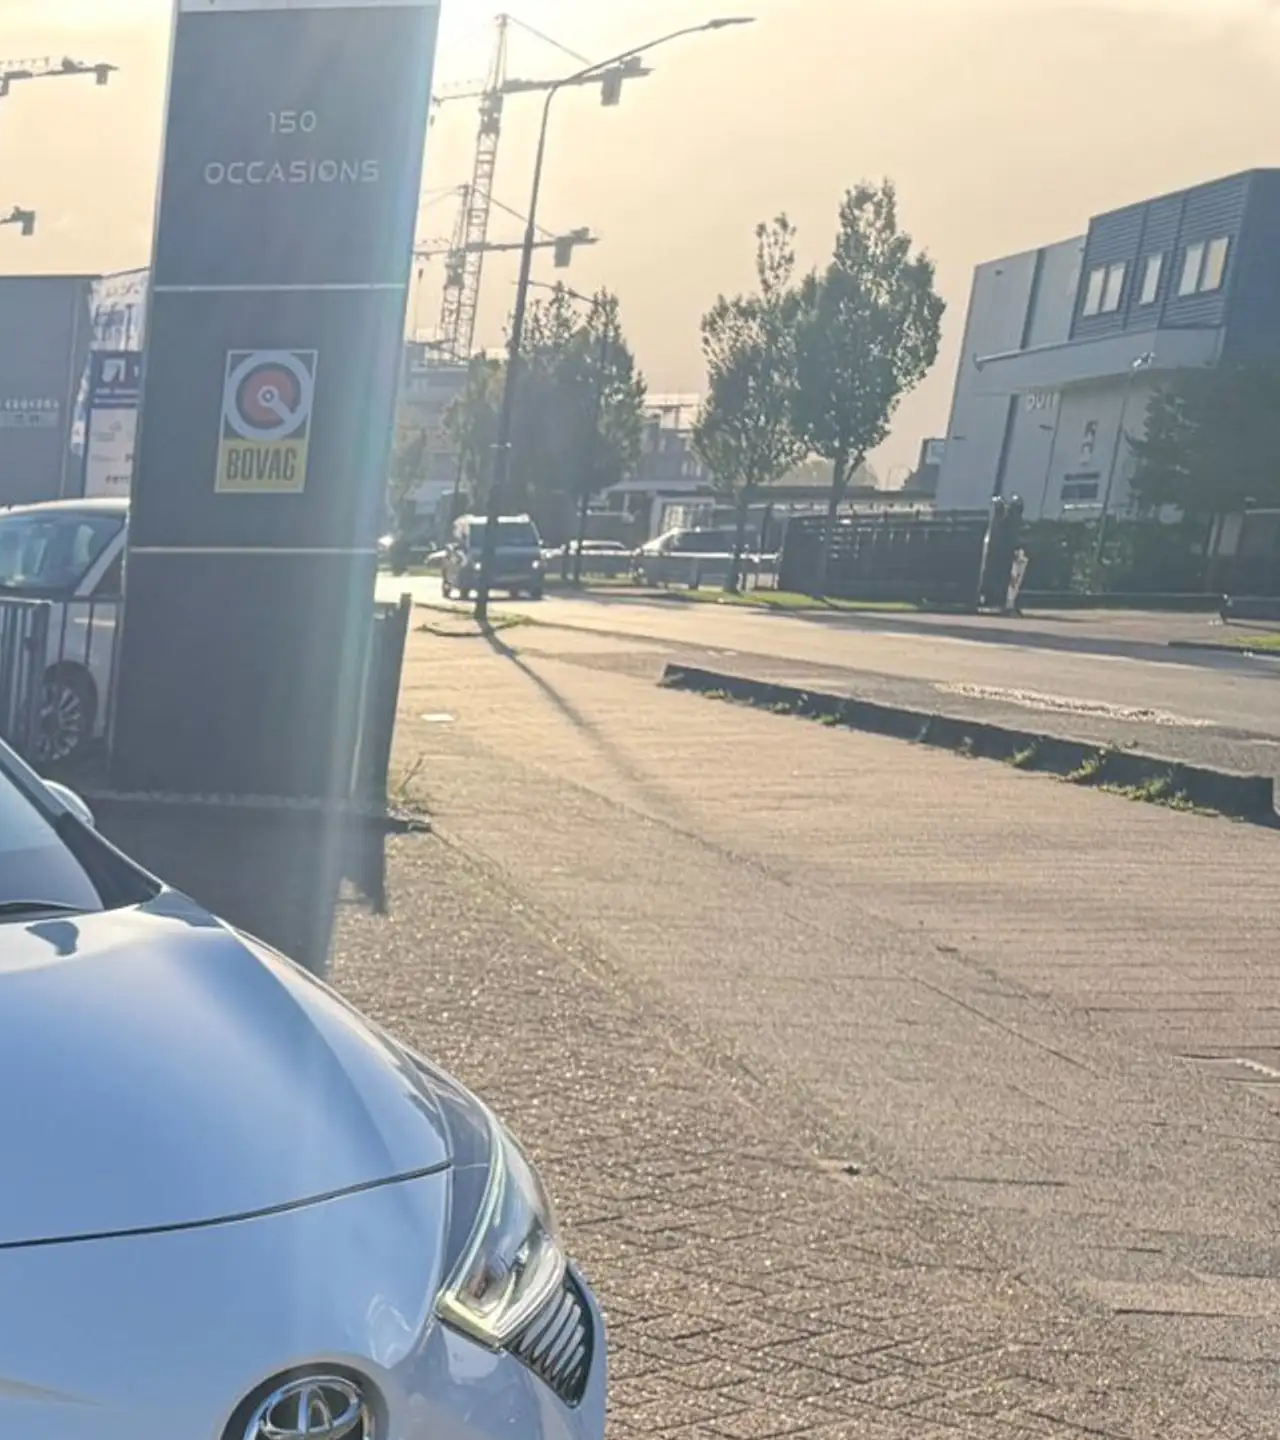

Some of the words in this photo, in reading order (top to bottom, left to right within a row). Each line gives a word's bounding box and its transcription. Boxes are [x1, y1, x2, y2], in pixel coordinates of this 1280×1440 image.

[268, 110, 317, 134] 150
[203, 158, 381, 185] OCCASIONS
[226, 447, 297, 481] BOVAG
